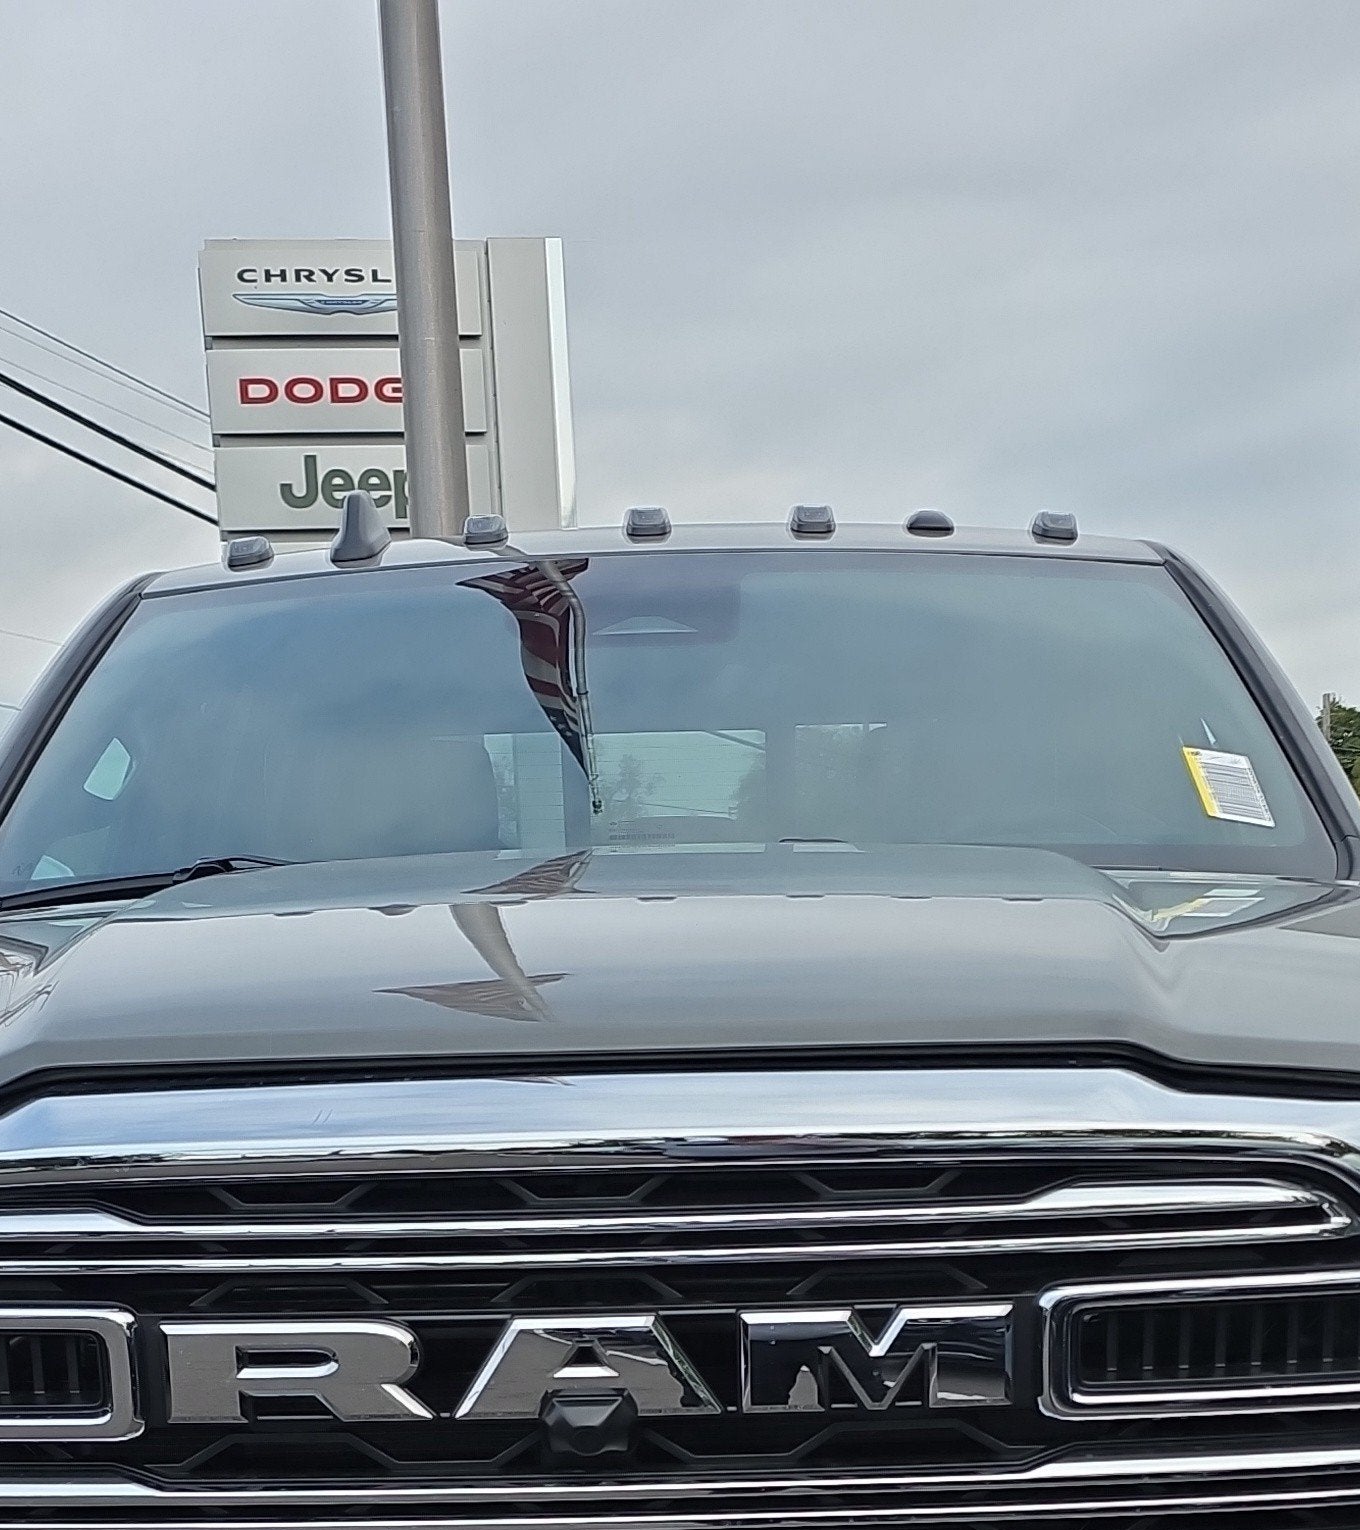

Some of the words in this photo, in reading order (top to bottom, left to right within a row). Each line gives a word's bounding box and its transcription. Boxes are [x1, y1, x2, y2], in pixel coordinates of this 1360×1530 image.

[237, 268, 393, 283] CHRYSL
[239, 376, 403, 405] DODG
[158, 1303, 1015, 1423] RAM
